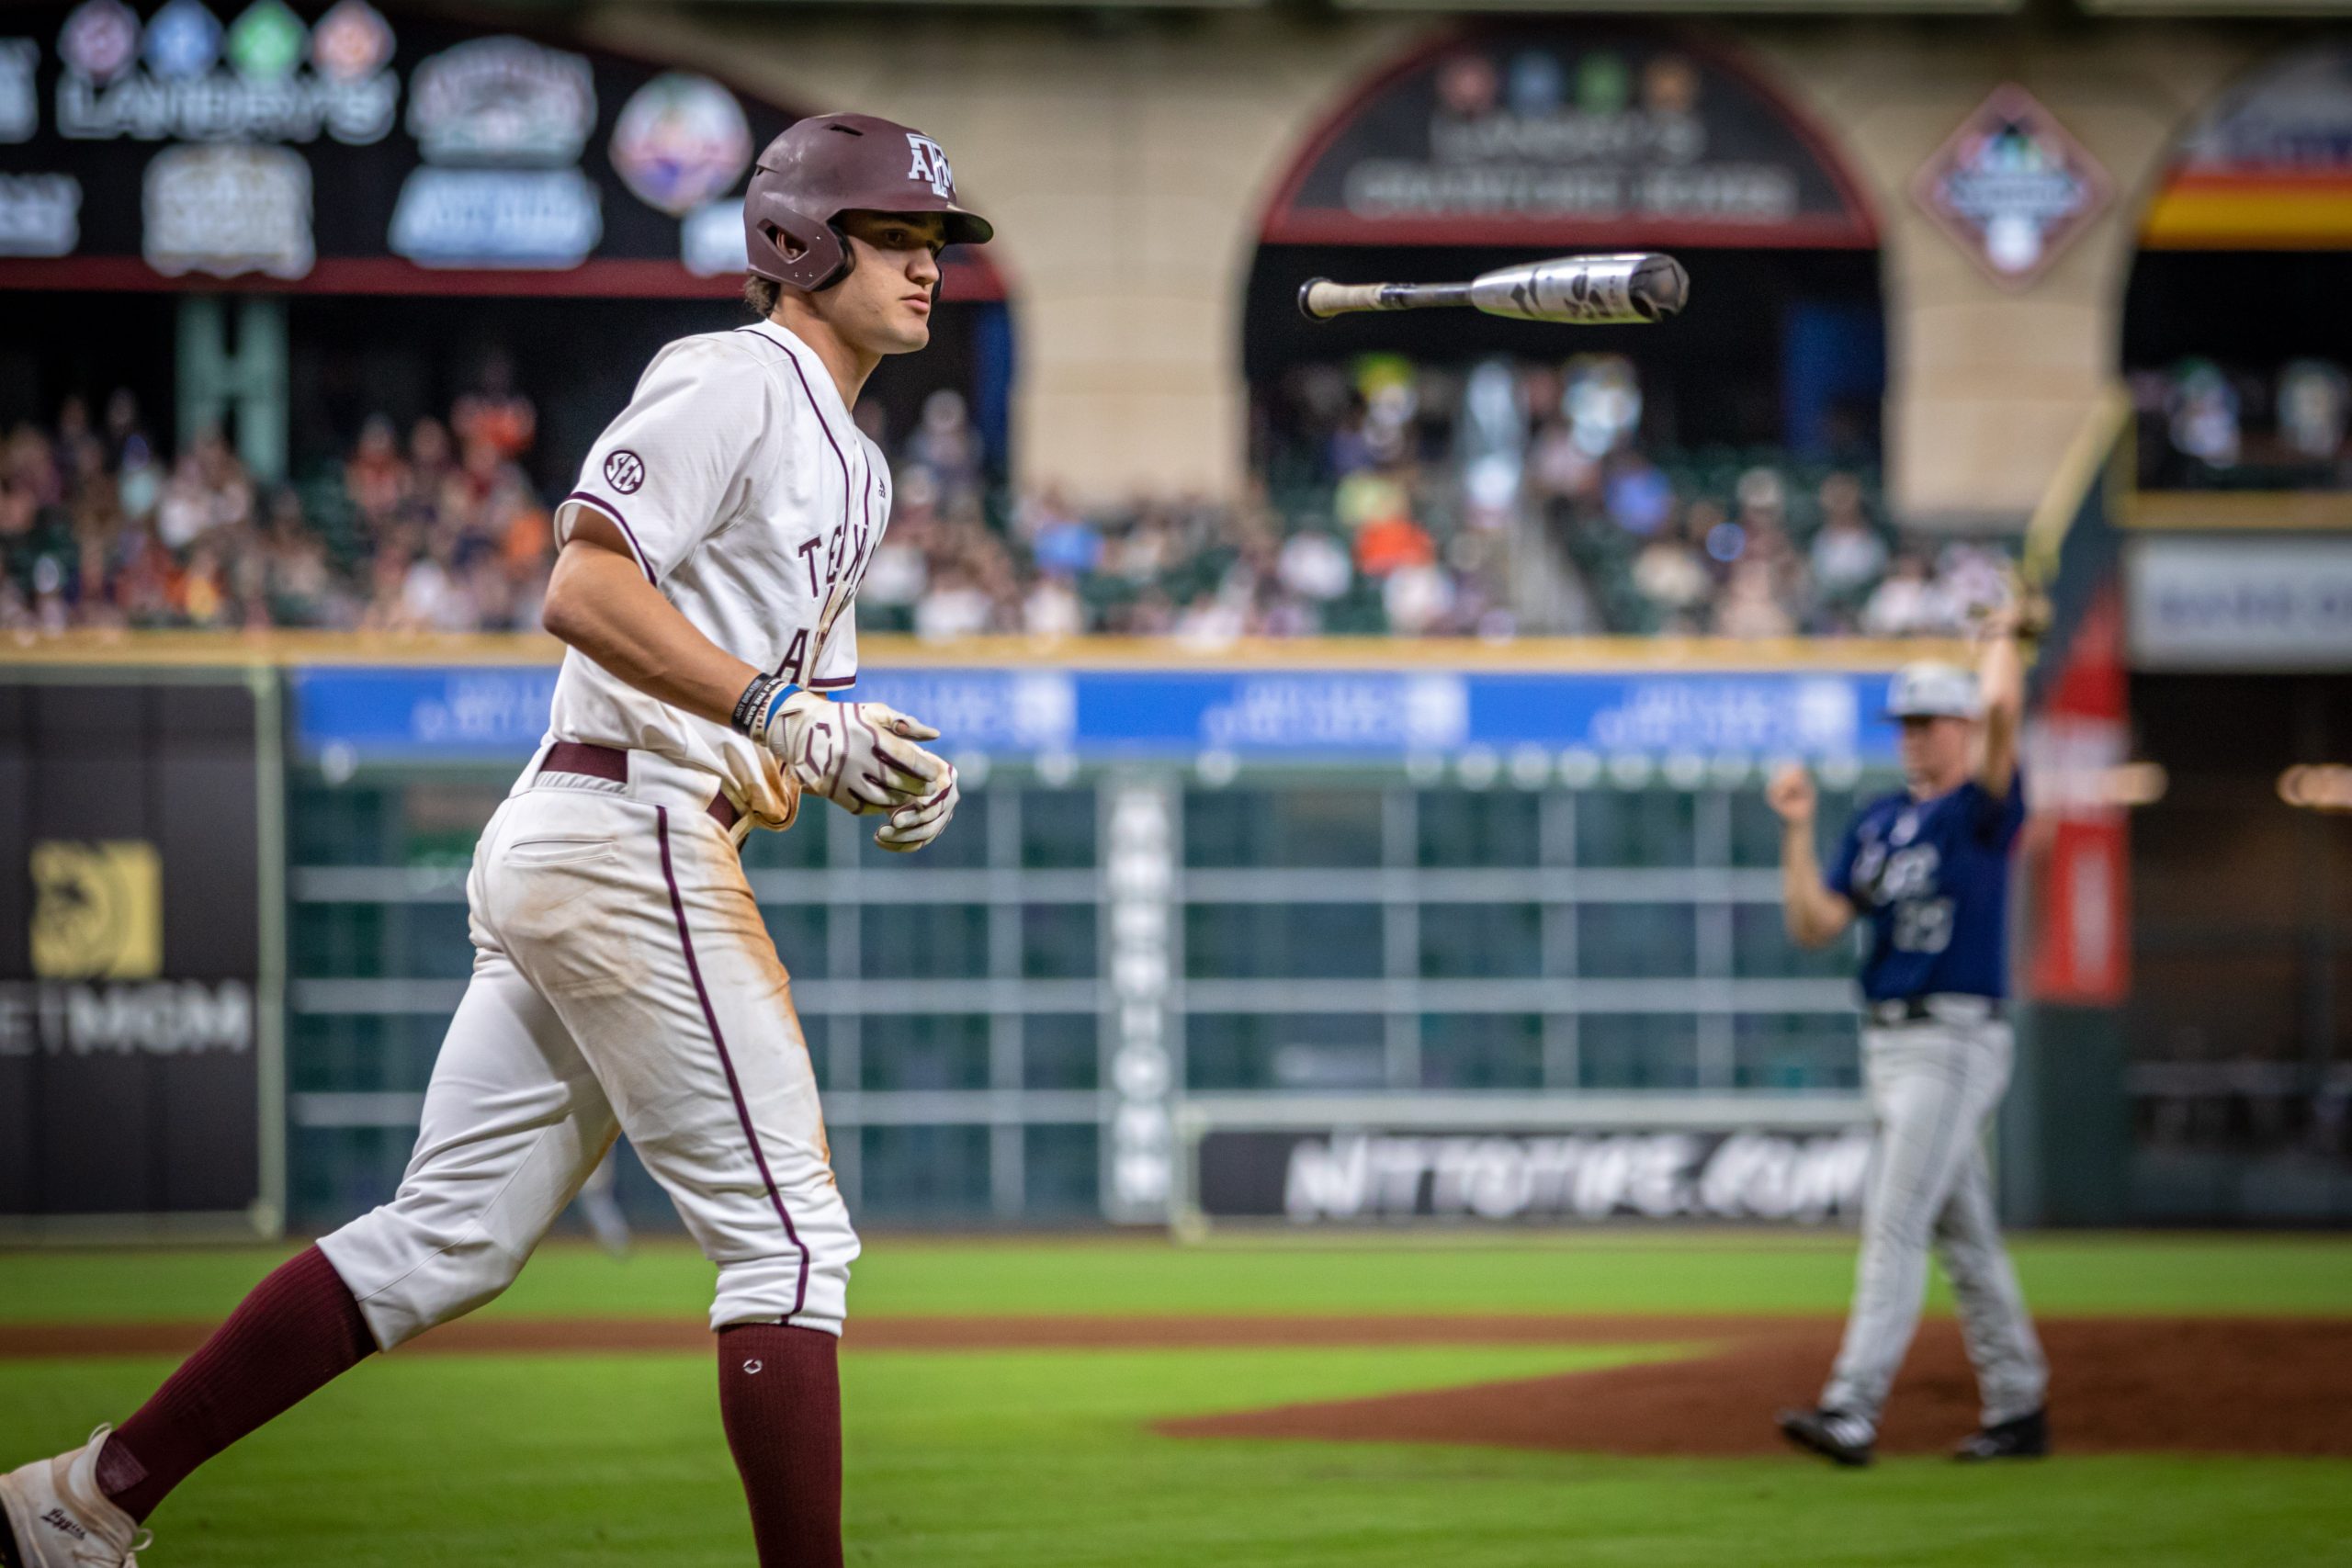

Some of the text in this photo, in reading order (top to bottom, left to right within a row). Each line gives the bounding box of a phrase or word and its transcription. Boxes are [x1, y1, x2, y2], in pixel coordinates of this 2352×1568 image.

[606, 453, 642, 491] SEC
[753, 692, 766, 706] THE
[743, 705, 757, 727] GAME
